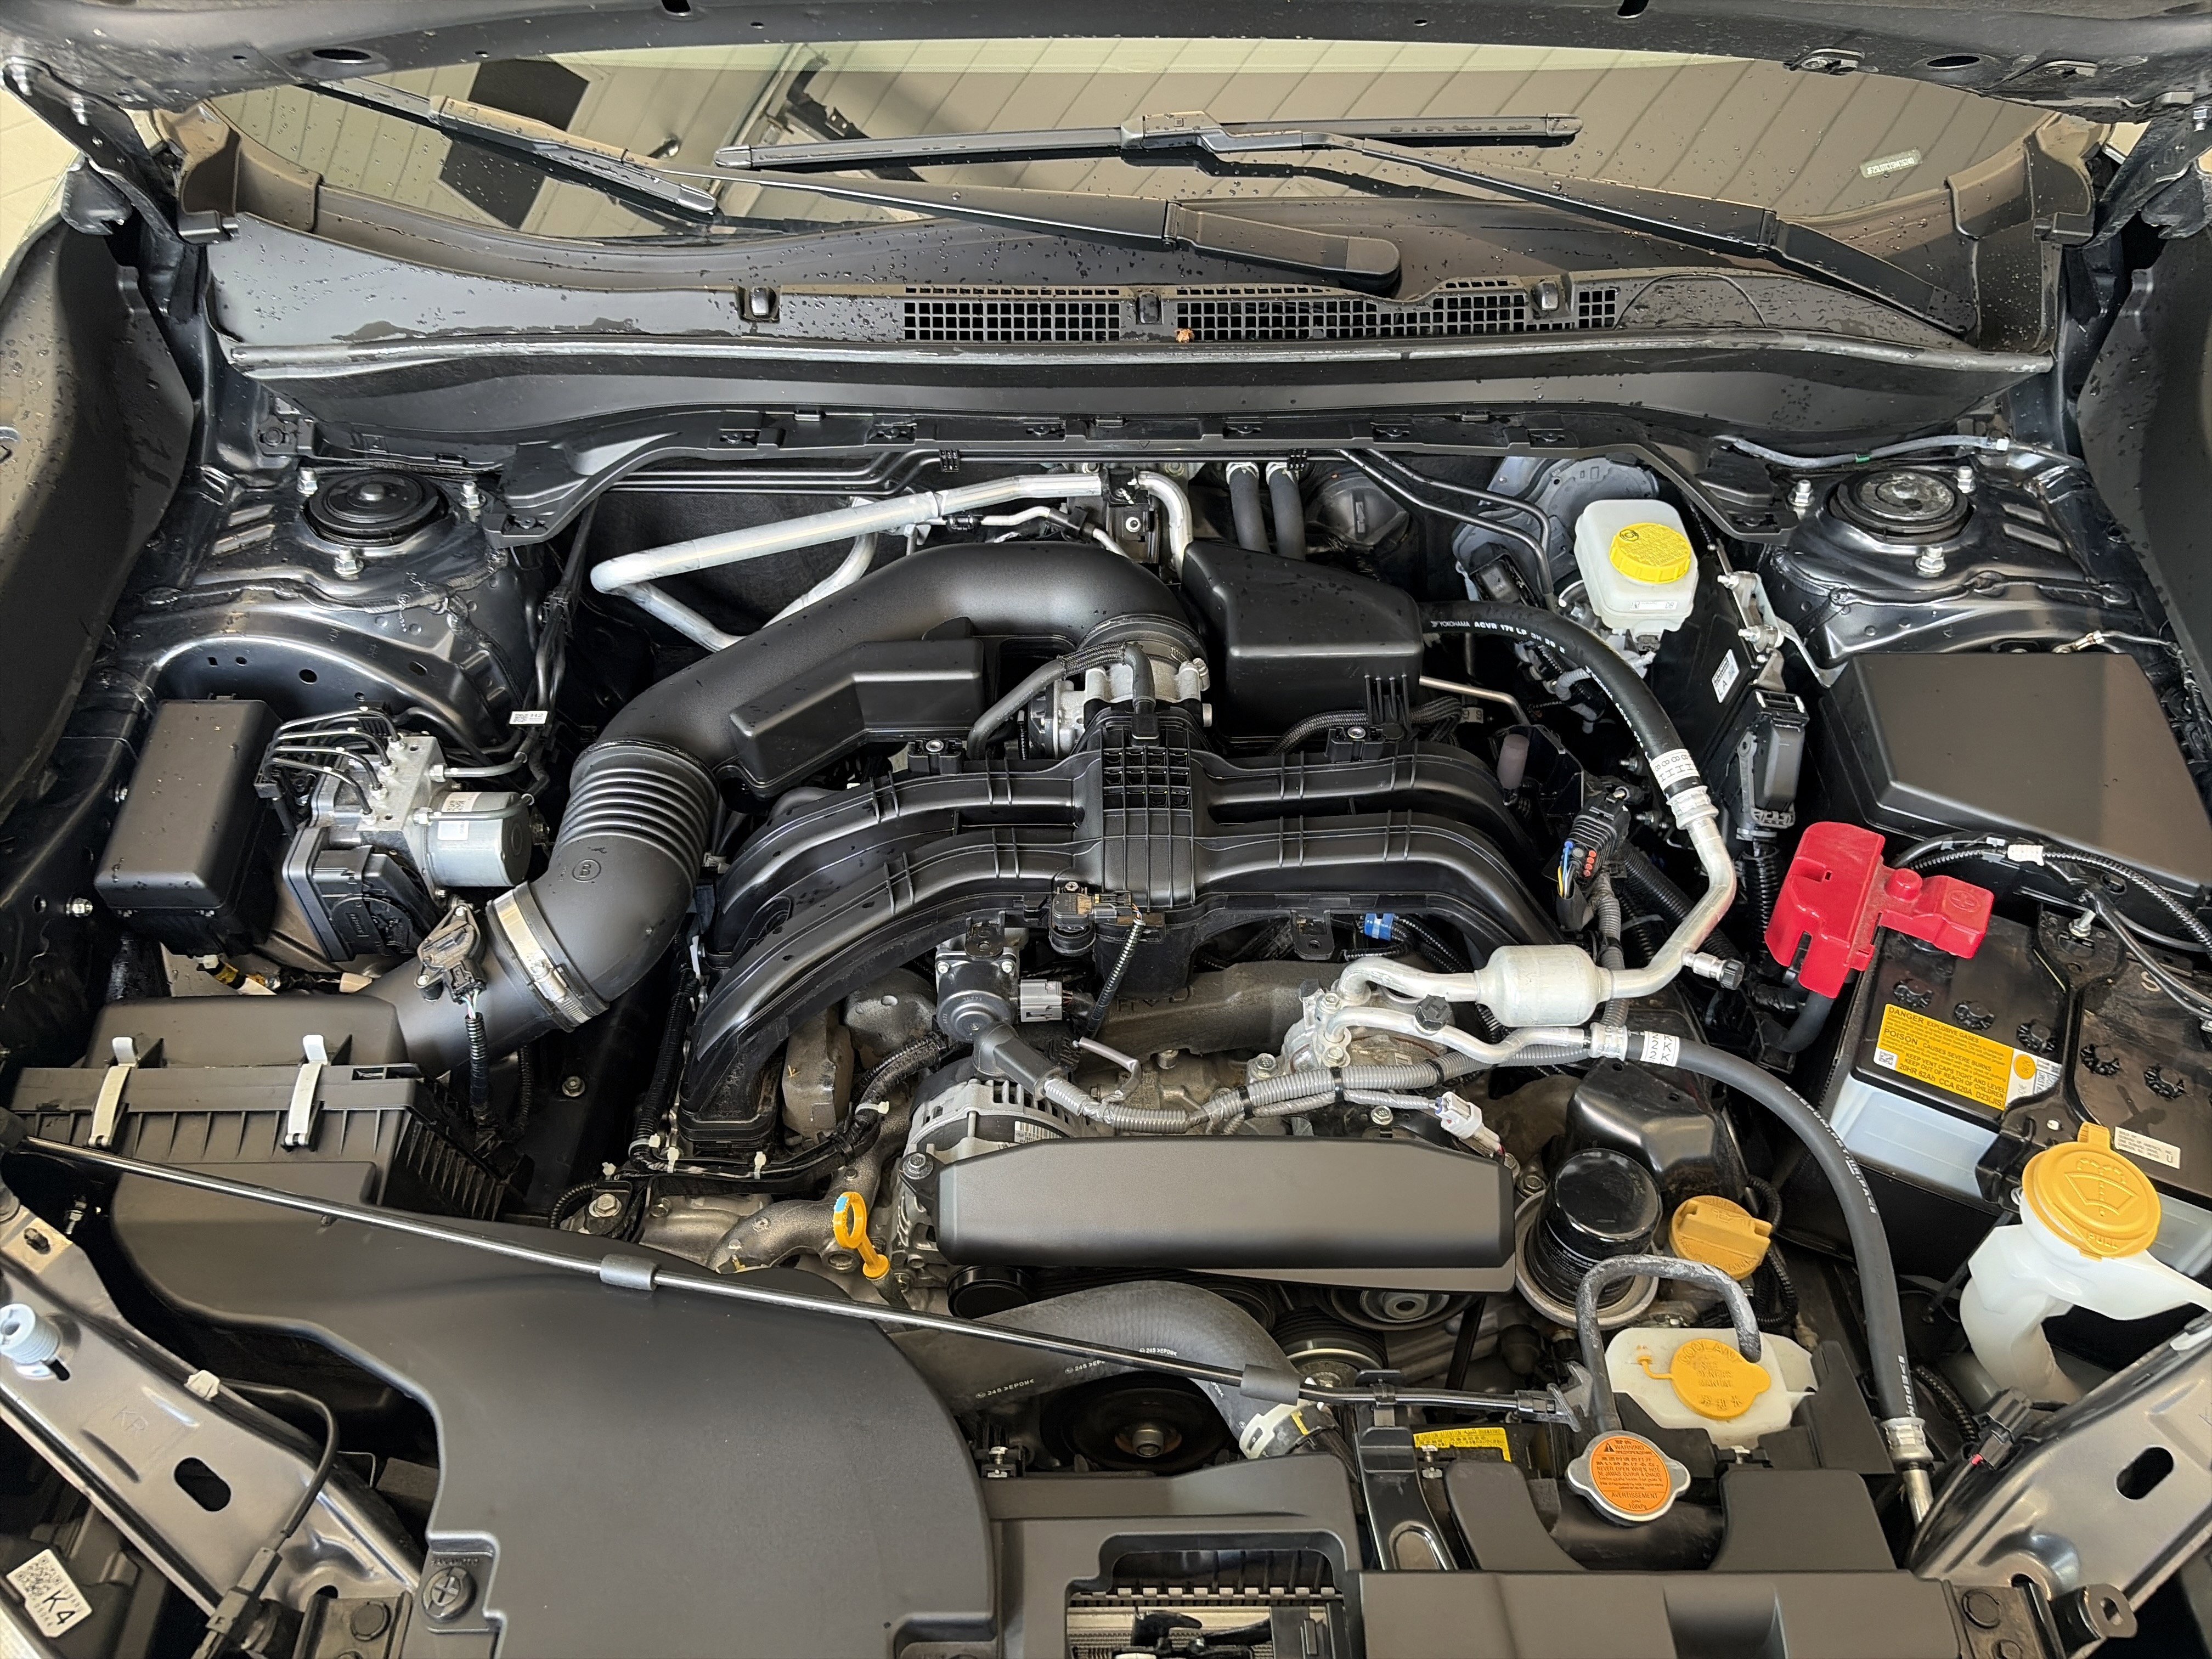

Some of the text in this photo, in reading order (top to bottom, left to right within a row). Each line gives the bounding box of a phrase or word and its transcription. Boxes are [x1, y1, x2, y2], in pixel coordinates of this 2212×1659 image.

[1888, 1006, 1979, 1043] DANGER EXPLOSIVE GASES
[1884, 1028, 1992, 1072] POISON CAUSES SEVERE BURNS
[1899, 1064, 1917, 1076] 20HR
[1938, 1077, 1954, 1090] CCA
[1904, 1058, 1920, 1068] KEEP
[1921, 1064, 1934, 1074] OUT
[1943, 1071, 1964, 1084] REACH
[1974, 1084, 2004, 1099] CHILDREN
[1906, 1052, 1921, 1062] KEEP
[1922, 1058, 1938, 1068] VENT
[1938, 1063, 1954, 1074] CAPS
[1955, 1069, 1973, 1081] TIGHT
[1974, 1076, 1986, 1086] AND
[1987, 1081, 2006, 1093] LEVEL
[2166, 1154, 2173, 1164] U
[1678, 1340, 1743, 1365] COOLANT
[41, 1589, 77, 1626] K4
